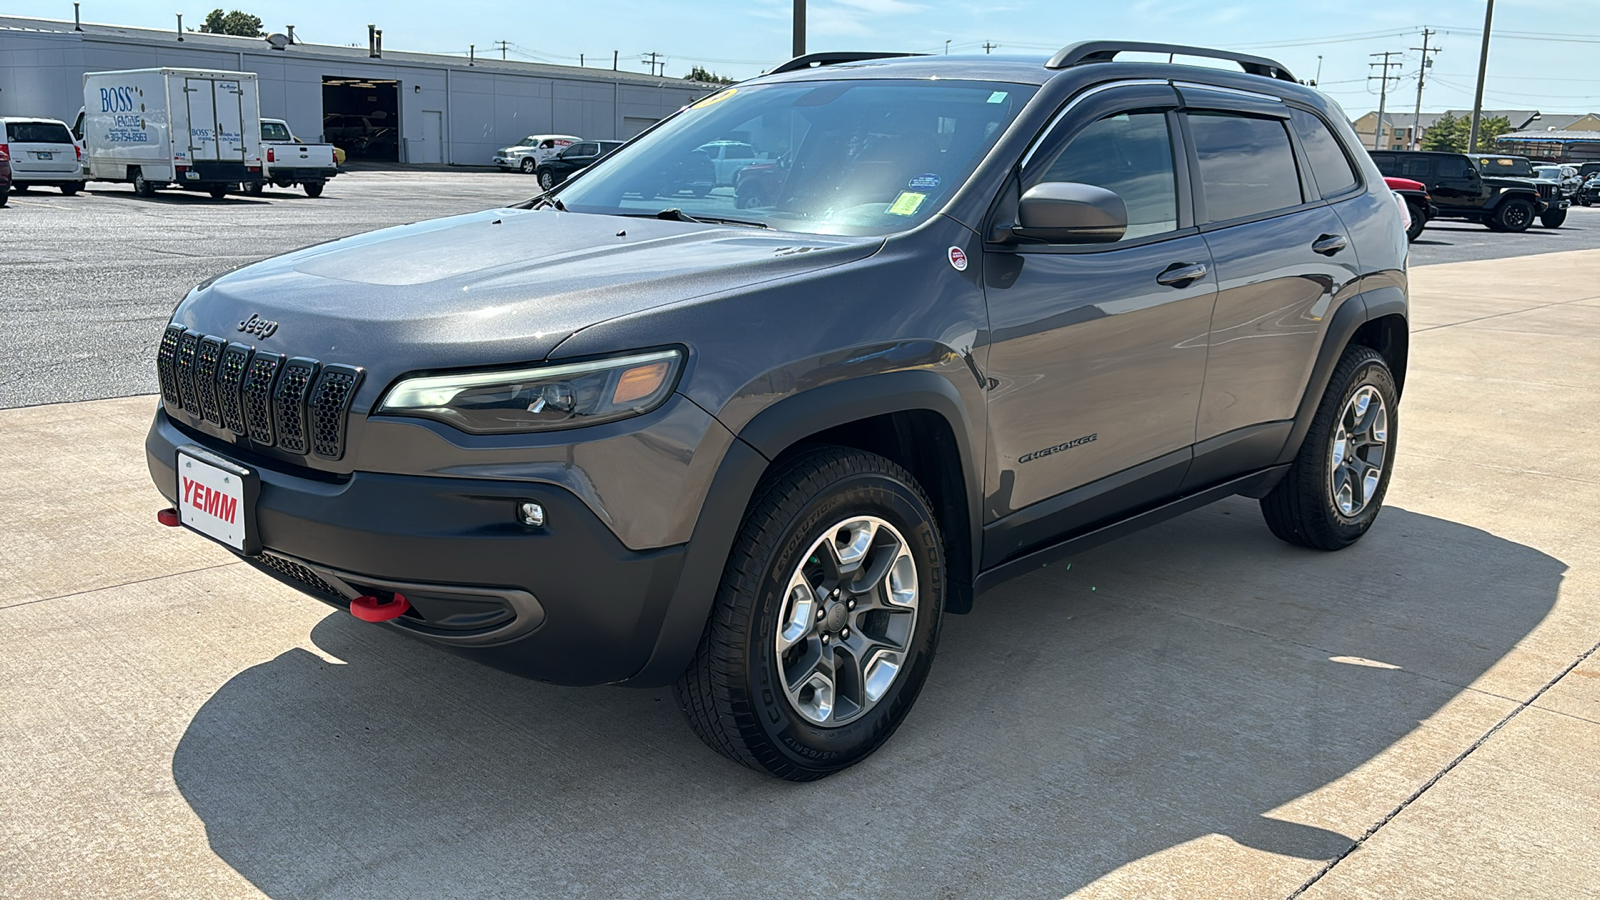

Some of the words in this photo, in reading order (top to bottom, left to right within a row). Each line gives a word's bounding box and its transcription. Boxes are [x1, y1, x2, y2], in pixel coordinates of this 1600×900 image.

[100, 86, 132, 113] BOSS
[191, 128, 209, 136] BOSS
[236, 312, 278, 340] Jeep
[1018, 433, 1097, 464] CHEROKEE
[182, 476, 237, 525] YEMM
[777, 497, 839, 572] EVOLUTION
